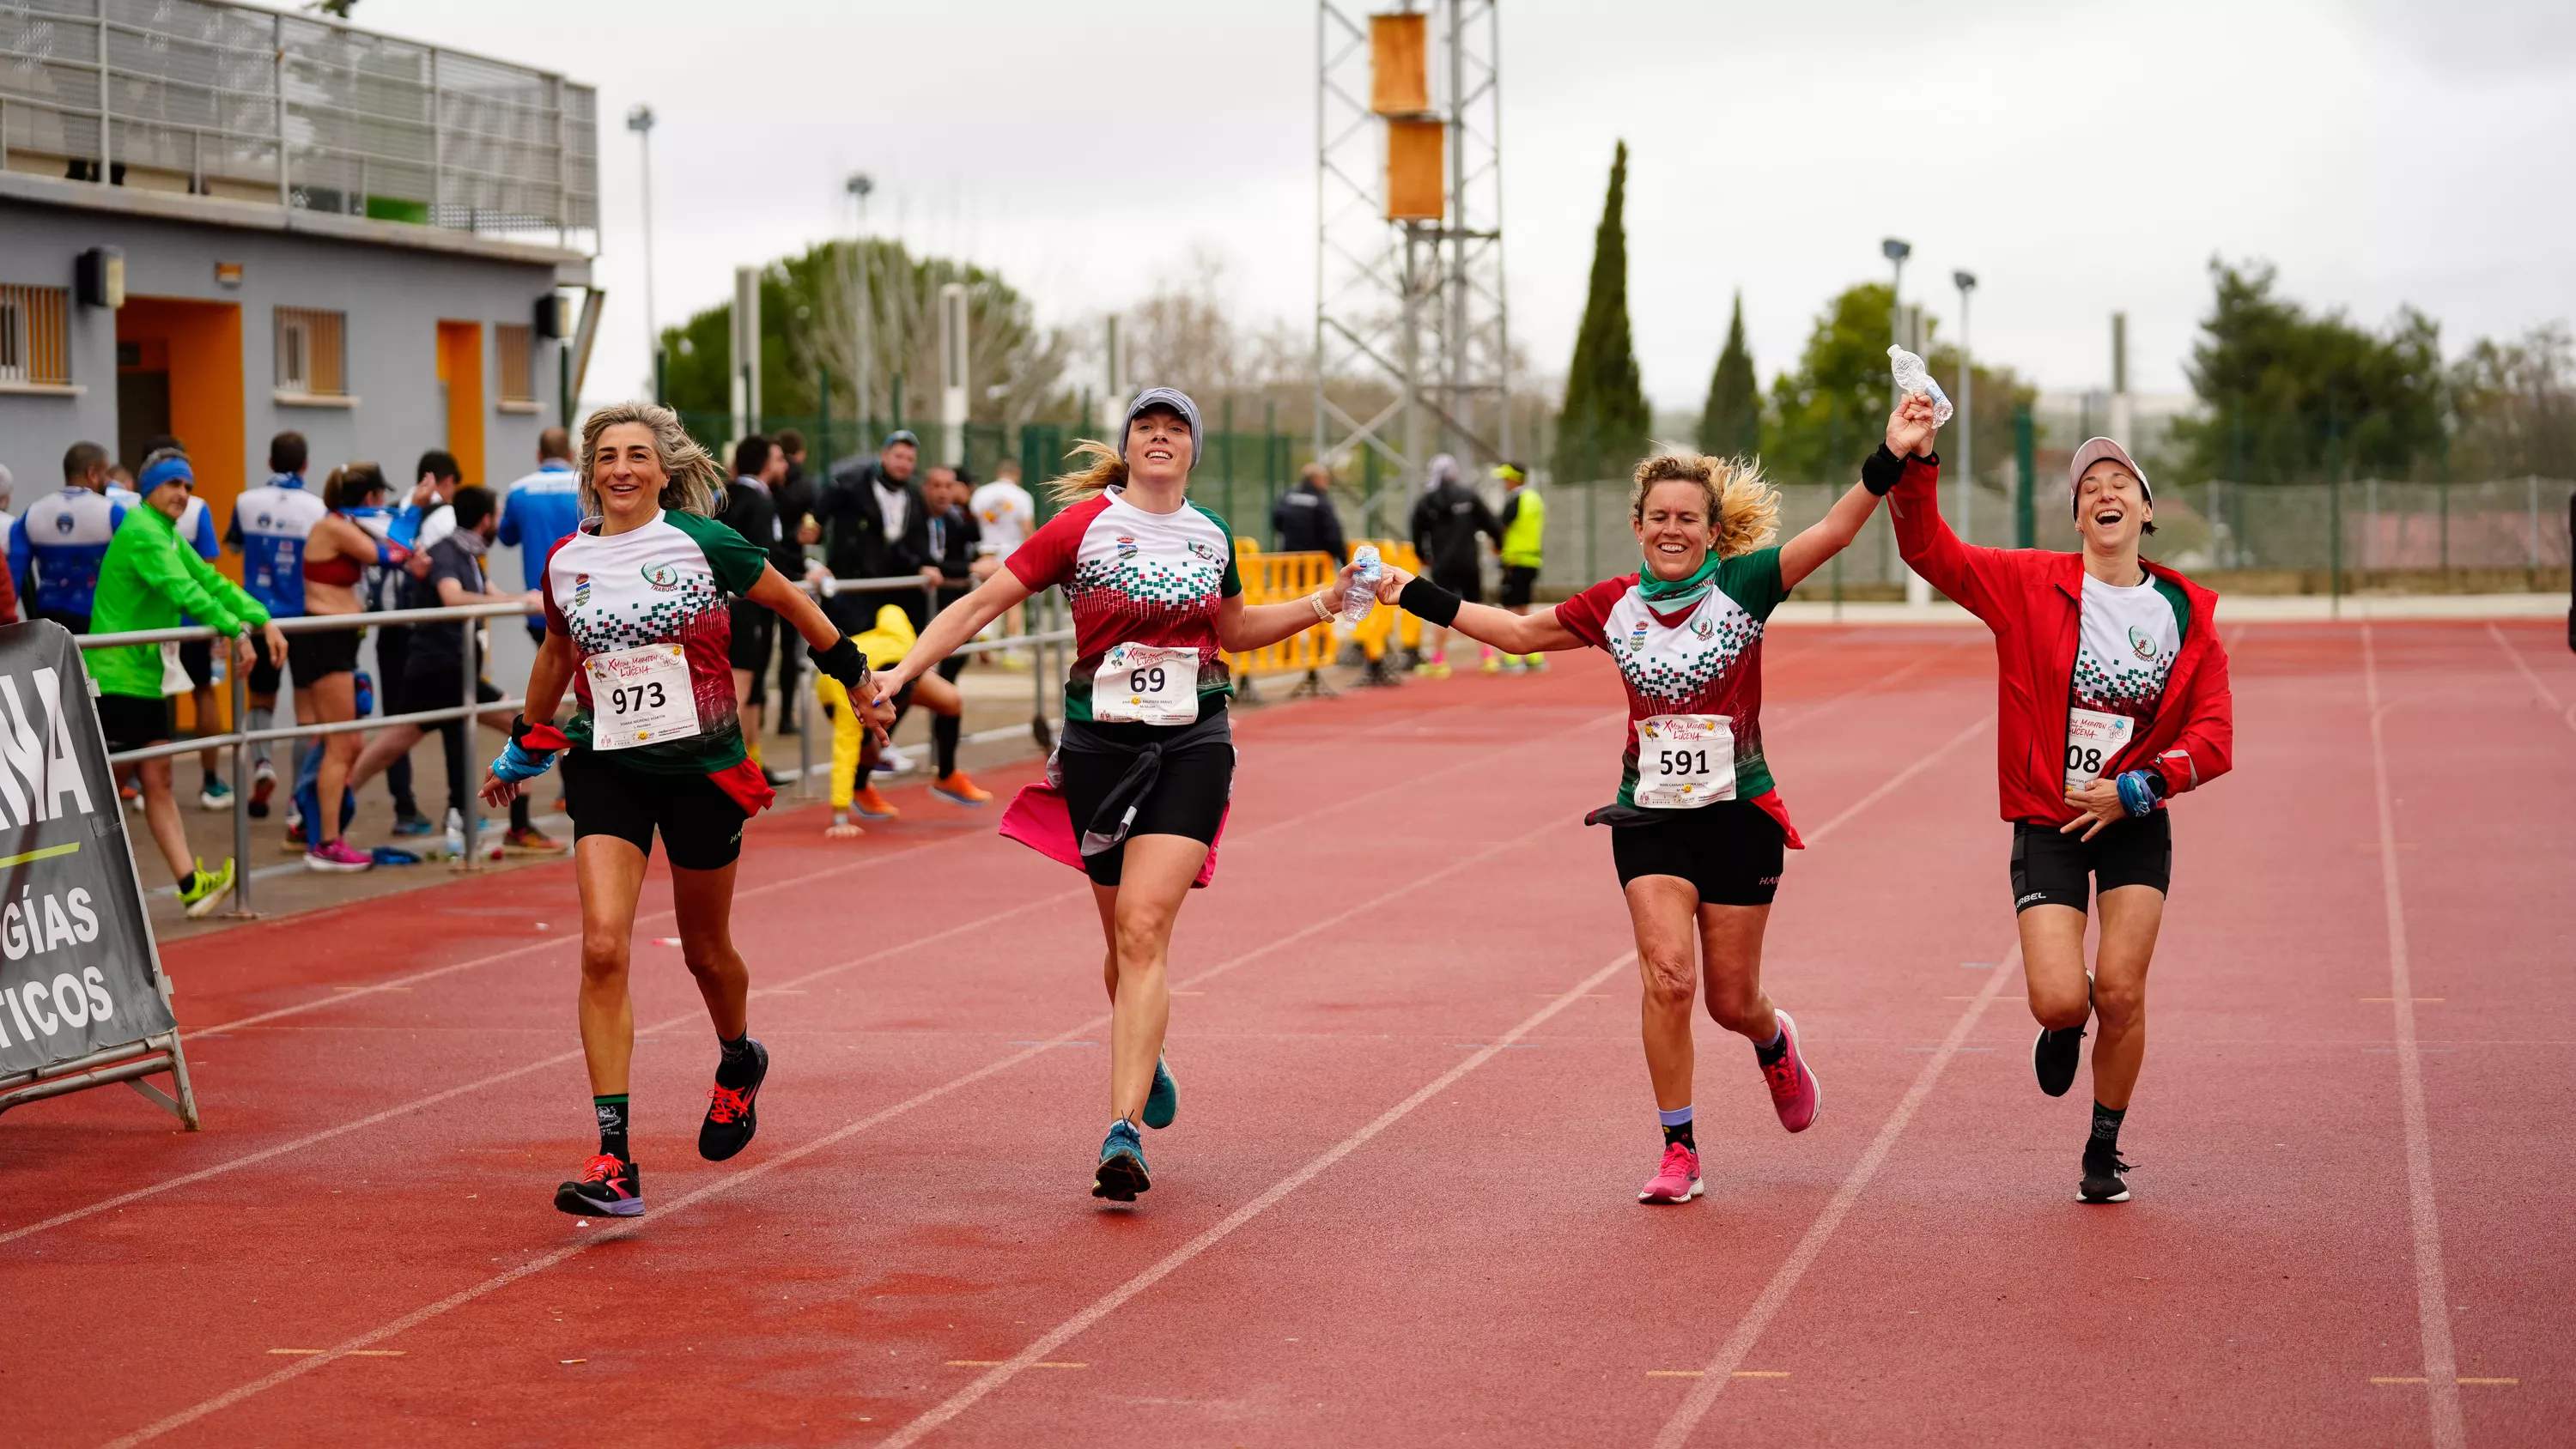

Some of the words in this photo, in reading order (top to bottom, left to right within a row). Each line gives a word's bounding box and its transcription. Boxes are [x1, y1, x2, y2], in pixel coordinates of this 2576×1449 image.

[651, 584, 677, 592] TRABUCO
[2133, 649, 2154, 662] TRABUCO
[620, 665, 650, 677] LUCENA
[1130, 667, 1165, 693] 69
[612, 682, 666, 714] 973
[1674, 731, 1701, 741] LUCENA
[2069, 727, 2099, 738] UCENA
[0, 666, 94, 830] NA
[1660, 749, 1710, 775] 591
[0, 884, 100, 961] GÍAS
